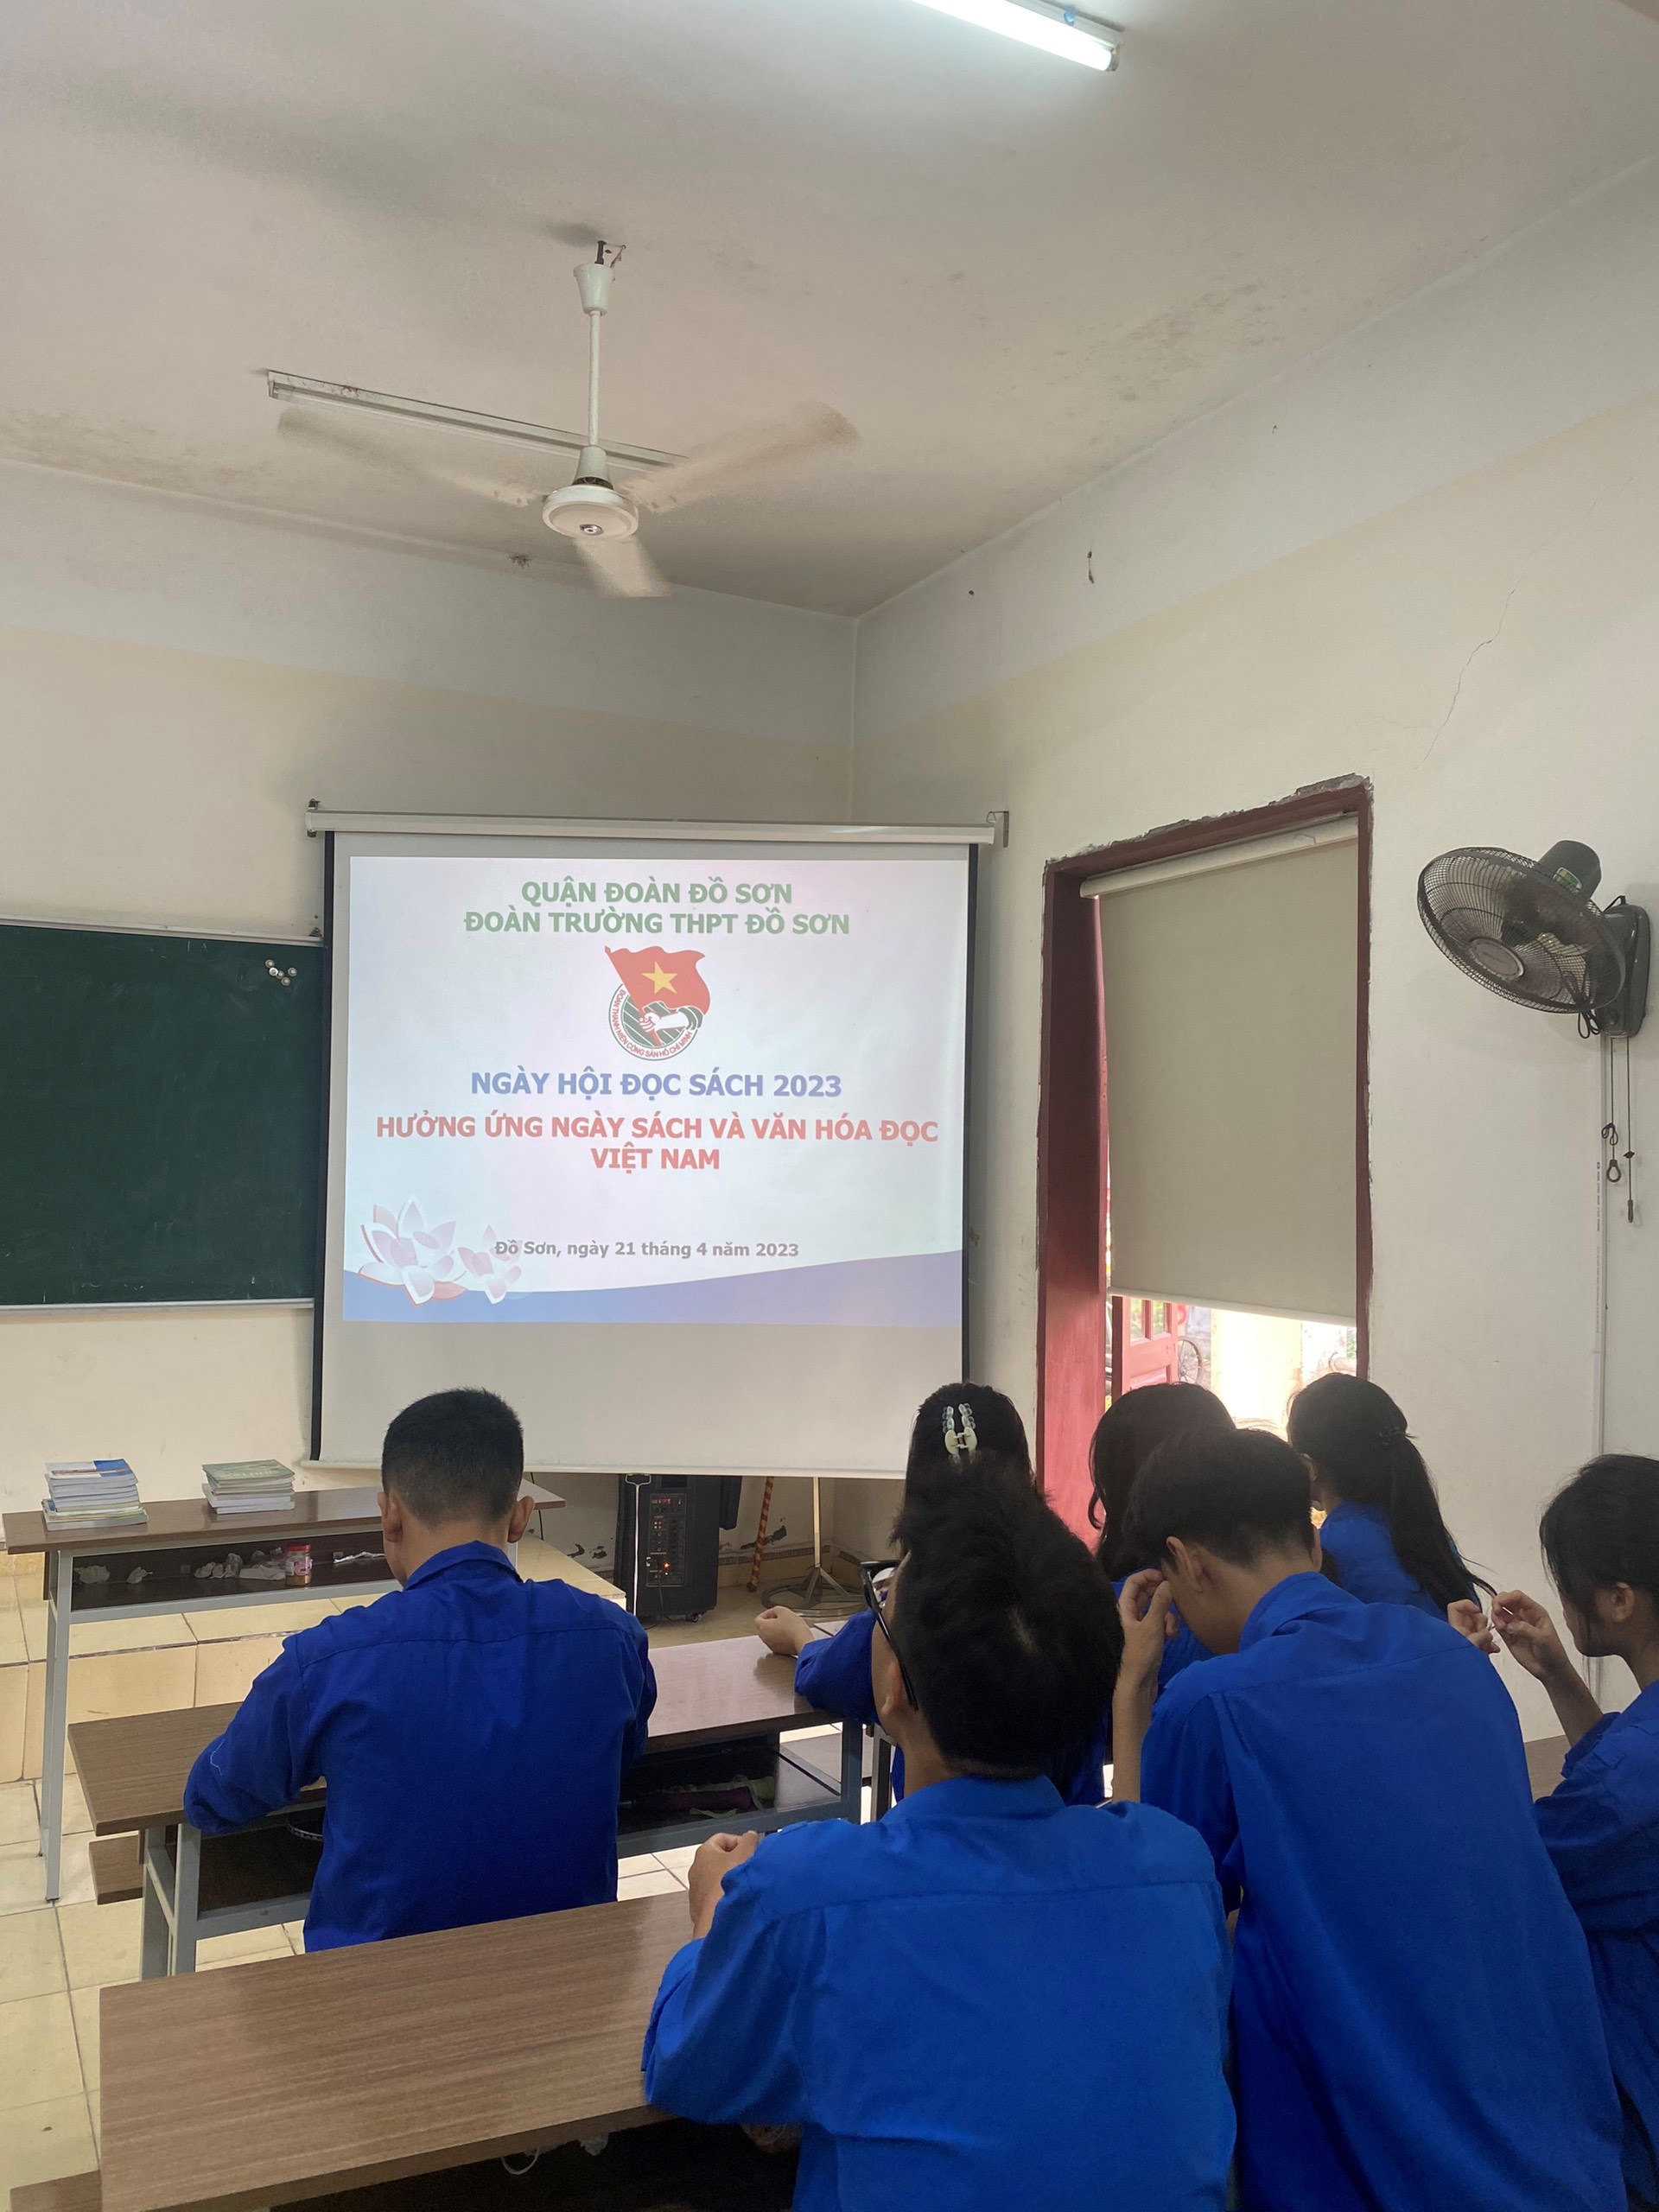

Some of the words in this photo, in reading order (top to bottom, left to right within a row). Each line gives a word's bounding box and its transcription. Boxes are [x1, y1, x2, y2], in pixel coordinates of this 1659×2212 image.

[521, 875, 596, 907] QUẬN
[604, 875, 680, 903] ĐOÀN
[688, 876, 728, 904] ĐỒ
[734, 883, 792, 904] SƠN
[463, 905, 541, 932] ĐOÀN
[548, 906, 663, 933] TRƯỜNG
[670, 913, 739, 934] THPT
[745, 906, 785, 934] ĐỒ
[791, 913, 849, 934] SƠN
[471, 1065, 550, 1095] NGÀY
[557, 1065, 613, 1101] HỘI
[620, 1073, 681, 1102] ĐỌC
[689, 1066, 764, 1096] SÁCH
[773, 1074, 842, 1097] 2023
[377, 1109, 476, 1138] HƯỞNG
[485, 1109, 543, 1138] ỨNG
[551, 1110, 626, 1139] NGÀY
[632, 1110, 702, 1139] SÁCH
[709, 1111, 746, 1139] VÀ
[751, 1112, 806, 1140] VĂN
[815, 1112, 873, 1141] HÓA
[879, 1120, 938, 1147] ĐỌC
[590, 1141, 653, 1174] VIỆT
[660, 1148, 720, 1170] NAM
[494, 1239, 519, 1255] Đồ
[524, 1241, 562, 1258] Sơn,
[567, 1239, 610, 1259] ngày
[615, 1242, 636, 1255] 21
[641, 1240, 692, 1260] tháng
[696, 1242, 708, 1256] 4
[712, 1241, 750, 1256] năm
[755, 1243, 799, 1257] 2023
